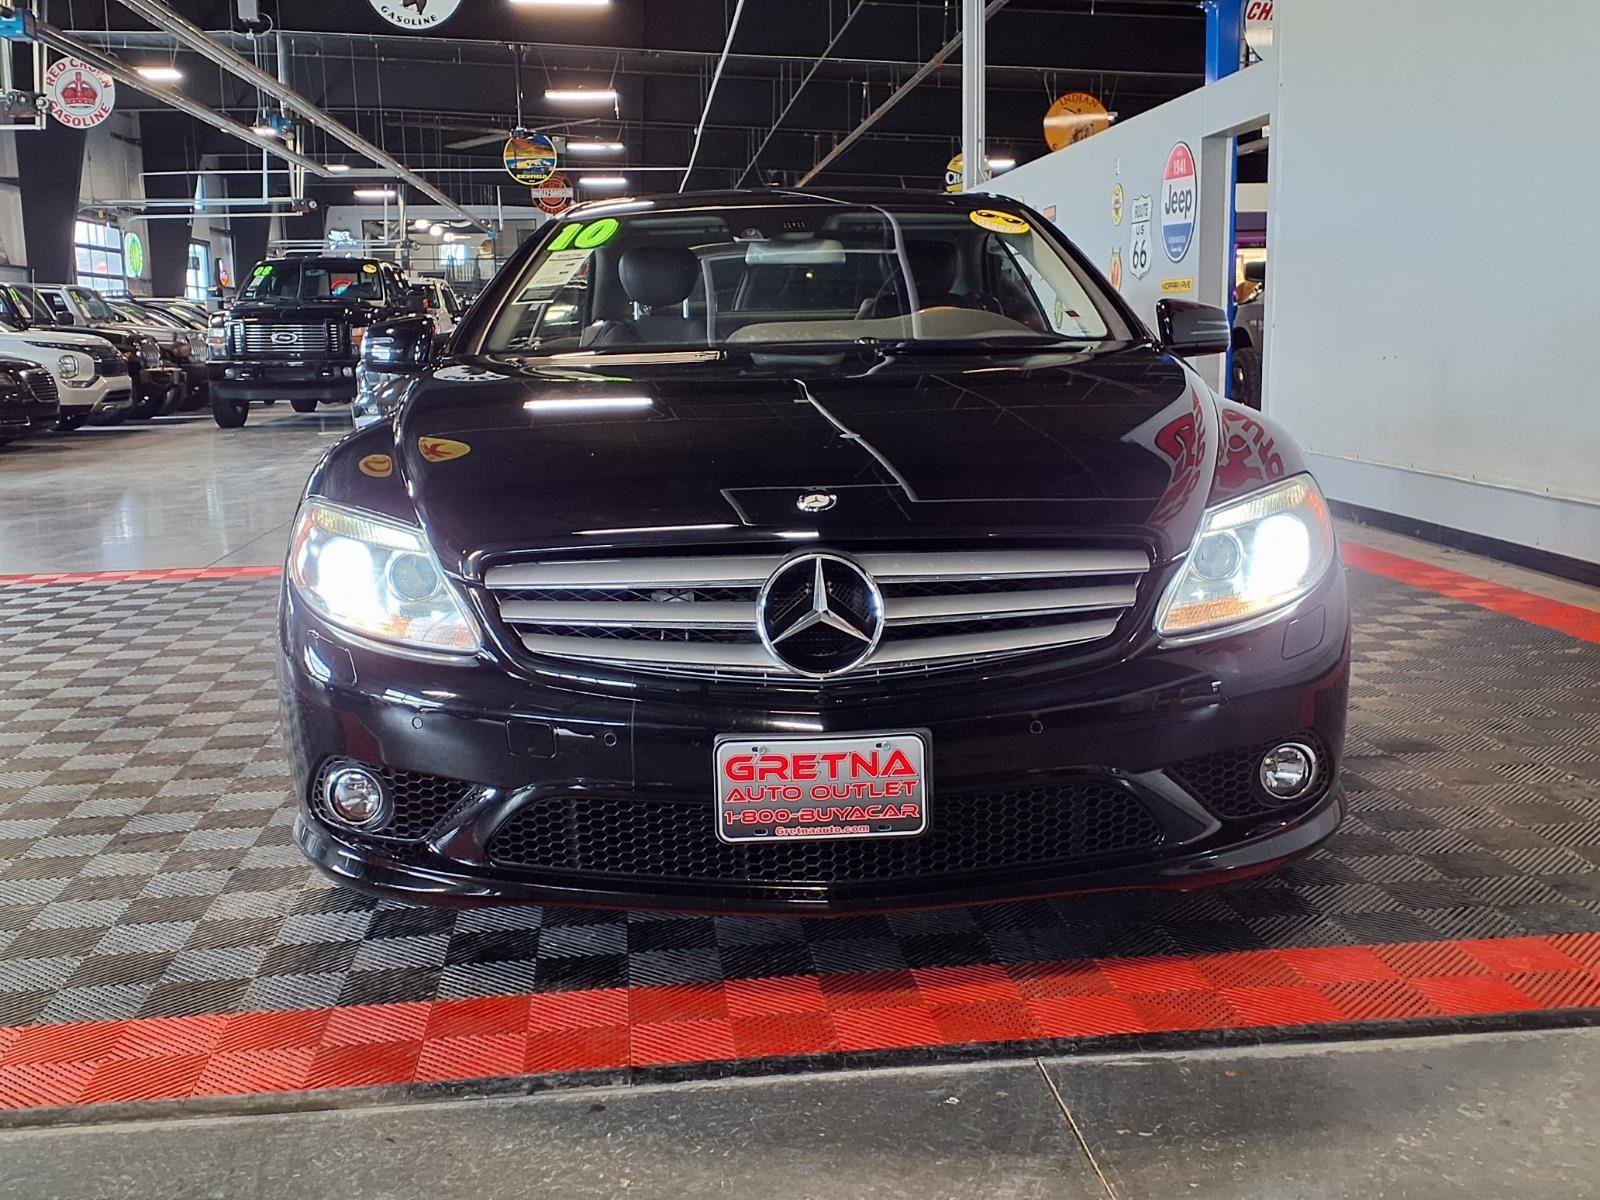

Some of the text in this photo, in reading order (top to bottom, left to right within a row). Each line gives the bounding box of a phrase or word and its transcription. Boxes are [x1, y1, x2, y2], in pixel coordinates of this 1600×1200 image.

[381, 5, 438, 25] GASOLINE
[1247, 2, 1273, 21] CH
[46, 61, 67, 87] RED
[1060, 94, 1099, 108] INDIAN
[1173, 158, 1187, 176] 1941
[1135, 203, 1149, 218] ROUTE
[1164, 184, 1192, 219] Jeep
[546, 217, 619, 252] 10
[1136, 224, 1145, 236] US
[1132, 239, 1147, 269] 66
[724, 748, 918, 783] GRETNA
[723, 779, 919, 804] AUTO OUTLET
[723, 803, 920, 826] 1-800-BUYACAR
[774, 824, 870, 837] Gretnaauto.com
